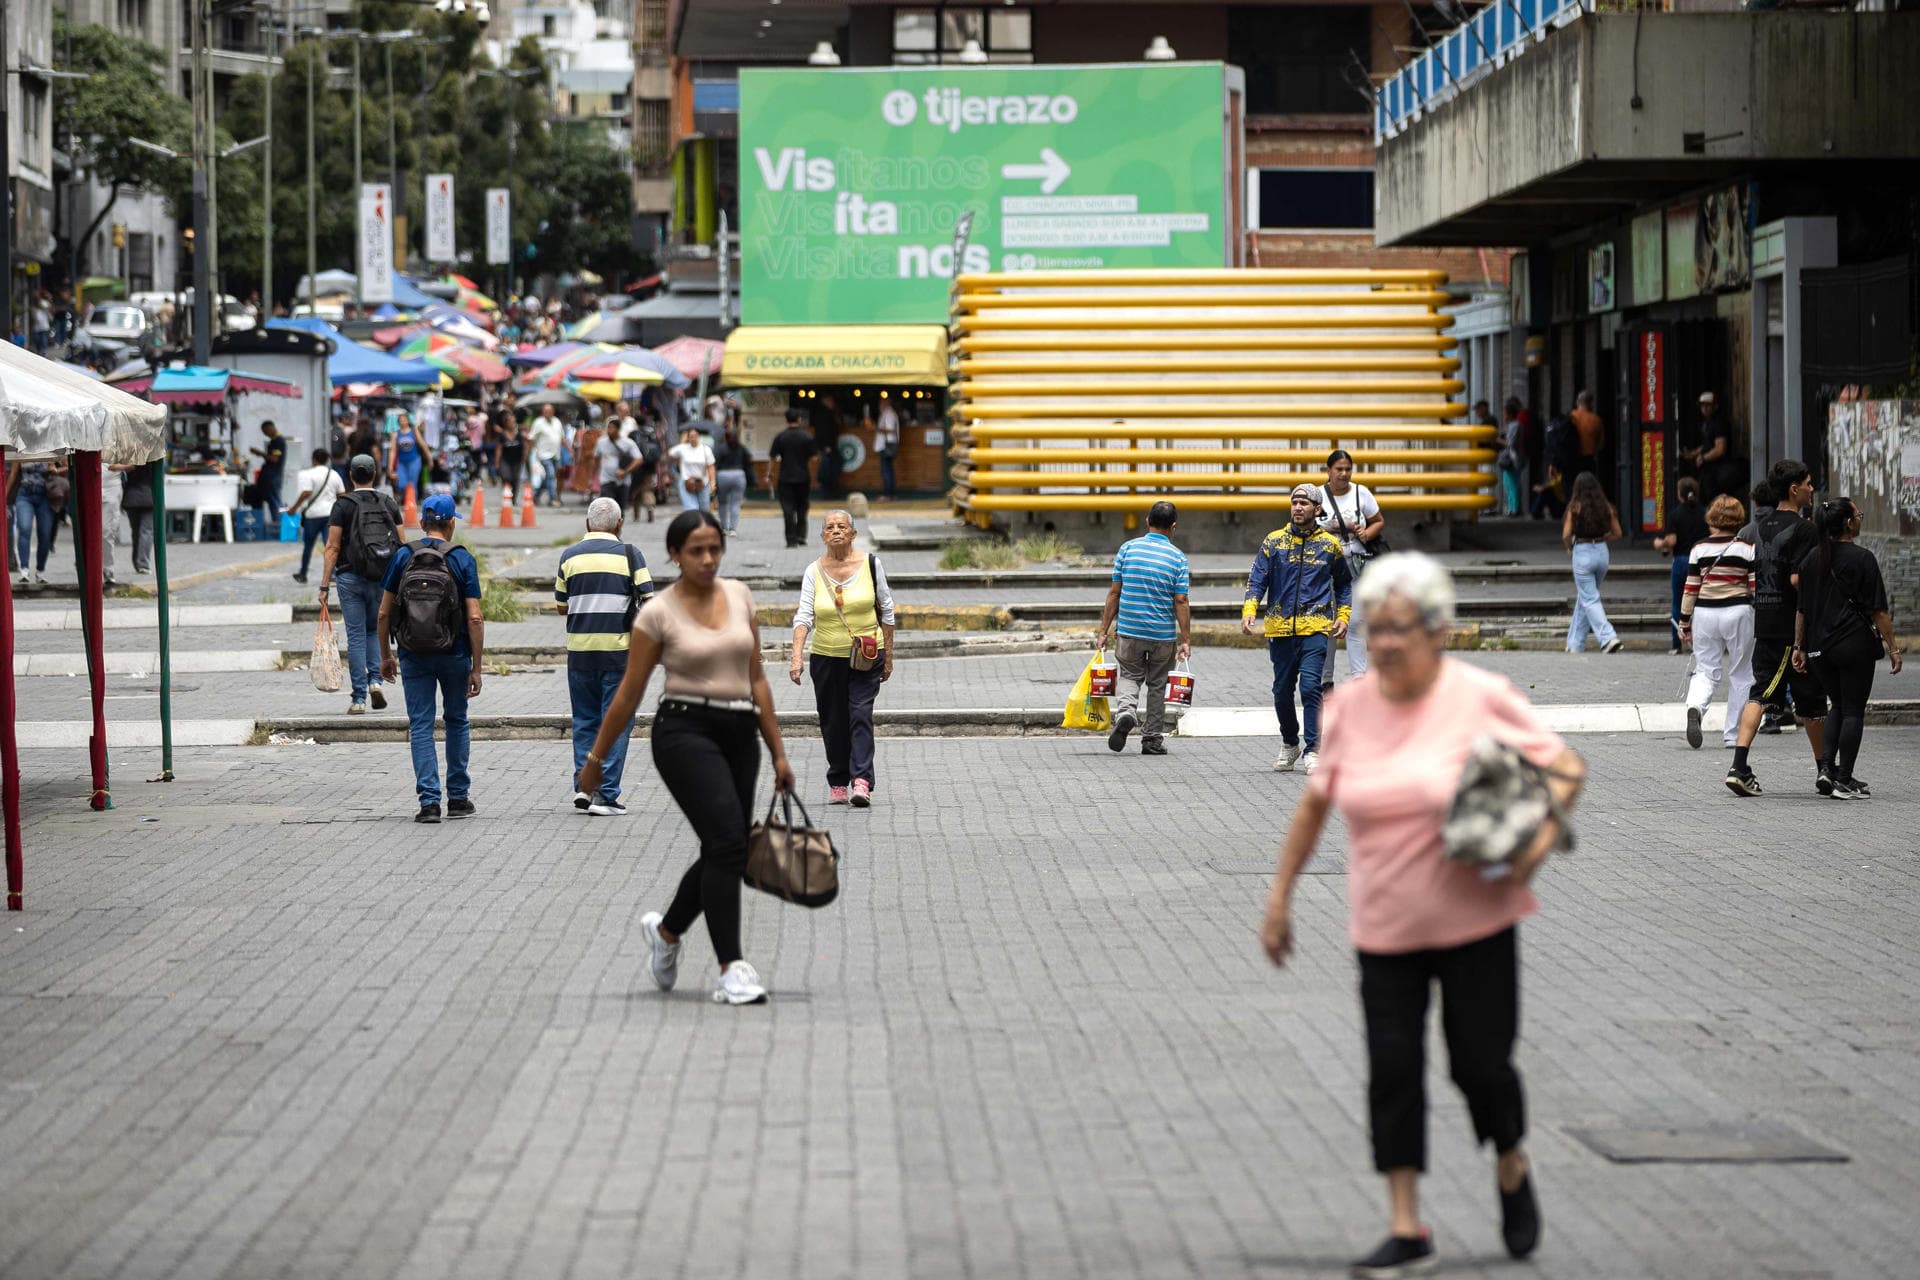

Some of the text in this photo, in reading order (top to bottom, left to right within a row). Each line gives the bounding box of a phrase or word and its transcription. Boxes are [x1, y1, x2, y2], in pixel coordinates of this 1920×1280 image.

[924, 87, 1077, 133] tijerazo
[760, 355, 825, 369] COCADA
[1647, 332, 1656, 421] FOTOCOPIAS
